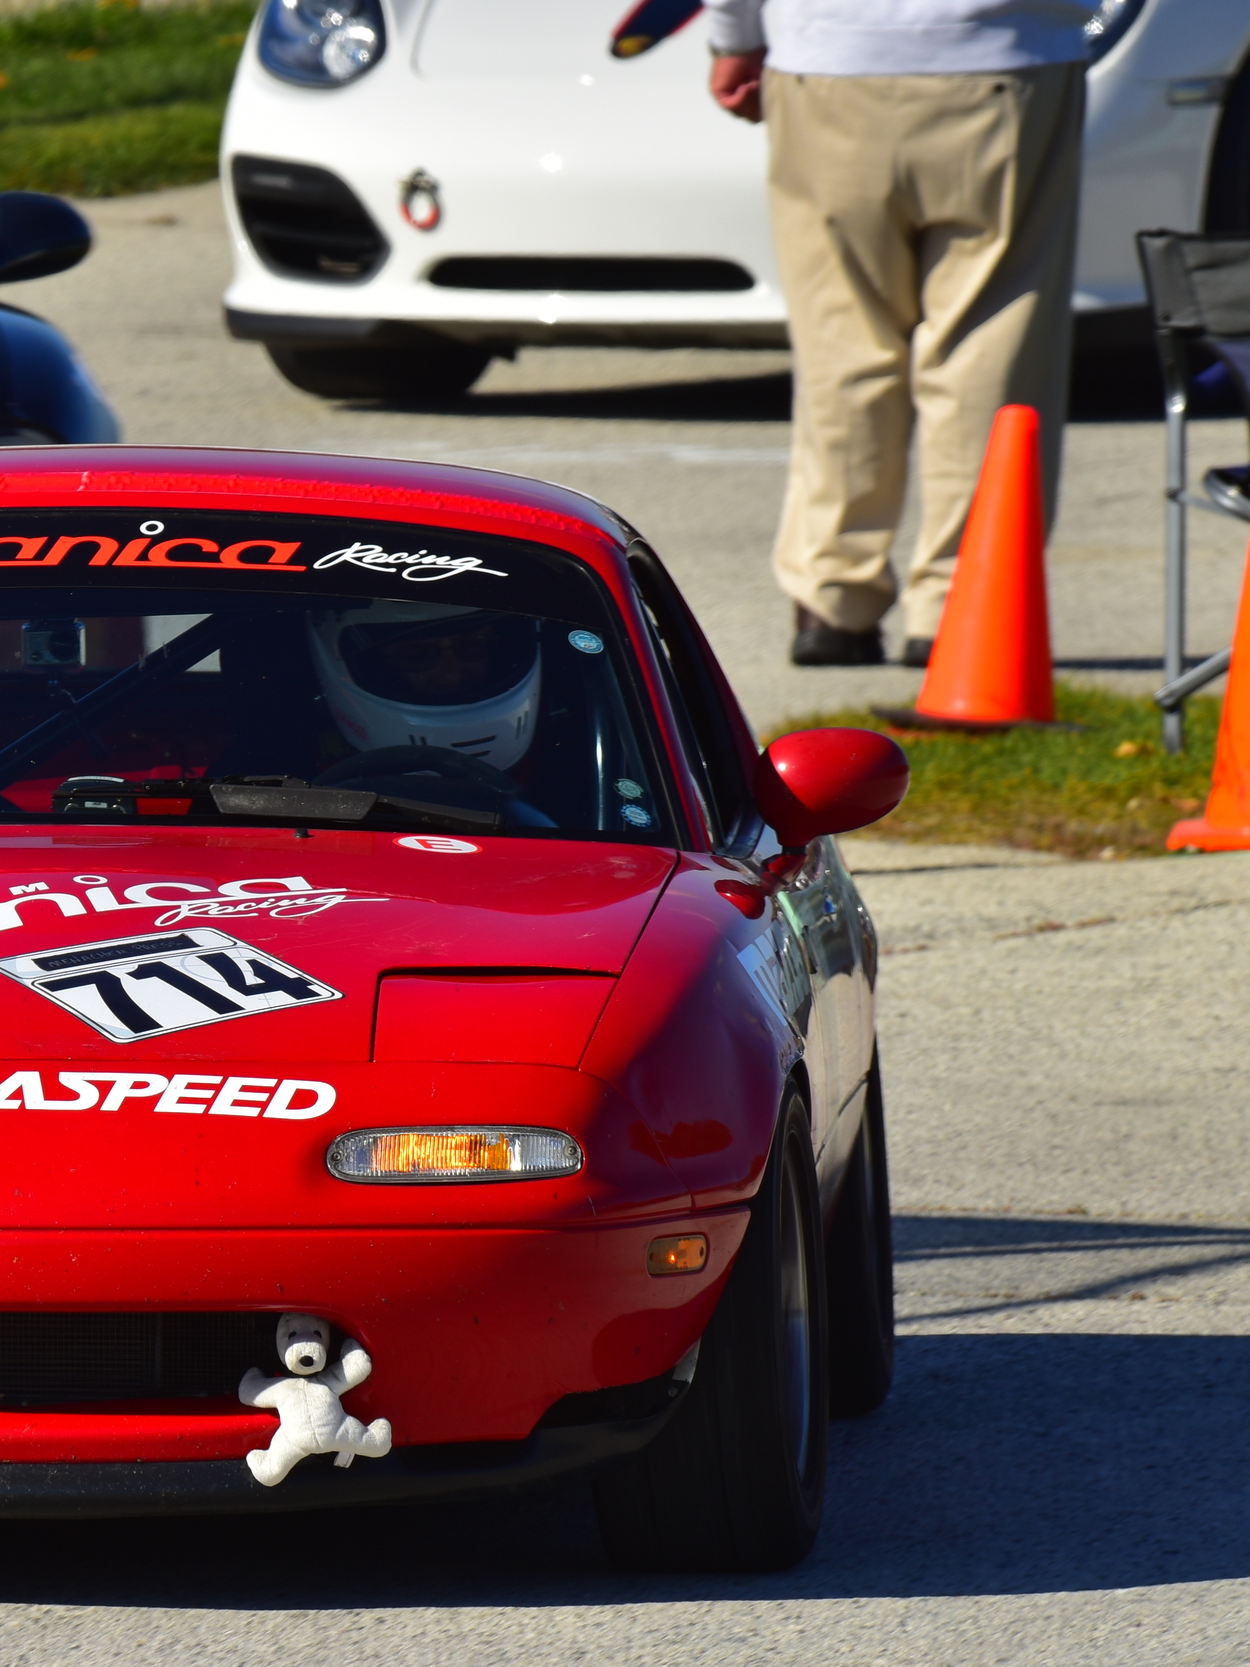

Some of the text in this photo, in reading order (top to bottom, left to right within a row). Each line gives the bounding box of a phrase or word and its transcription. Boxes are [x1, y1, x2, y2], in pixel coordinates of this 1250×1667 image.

[312, 542, 509, 582] Racing
[154, 894, 391, 927] Racing
[38, 951, 322, 1035] 714
